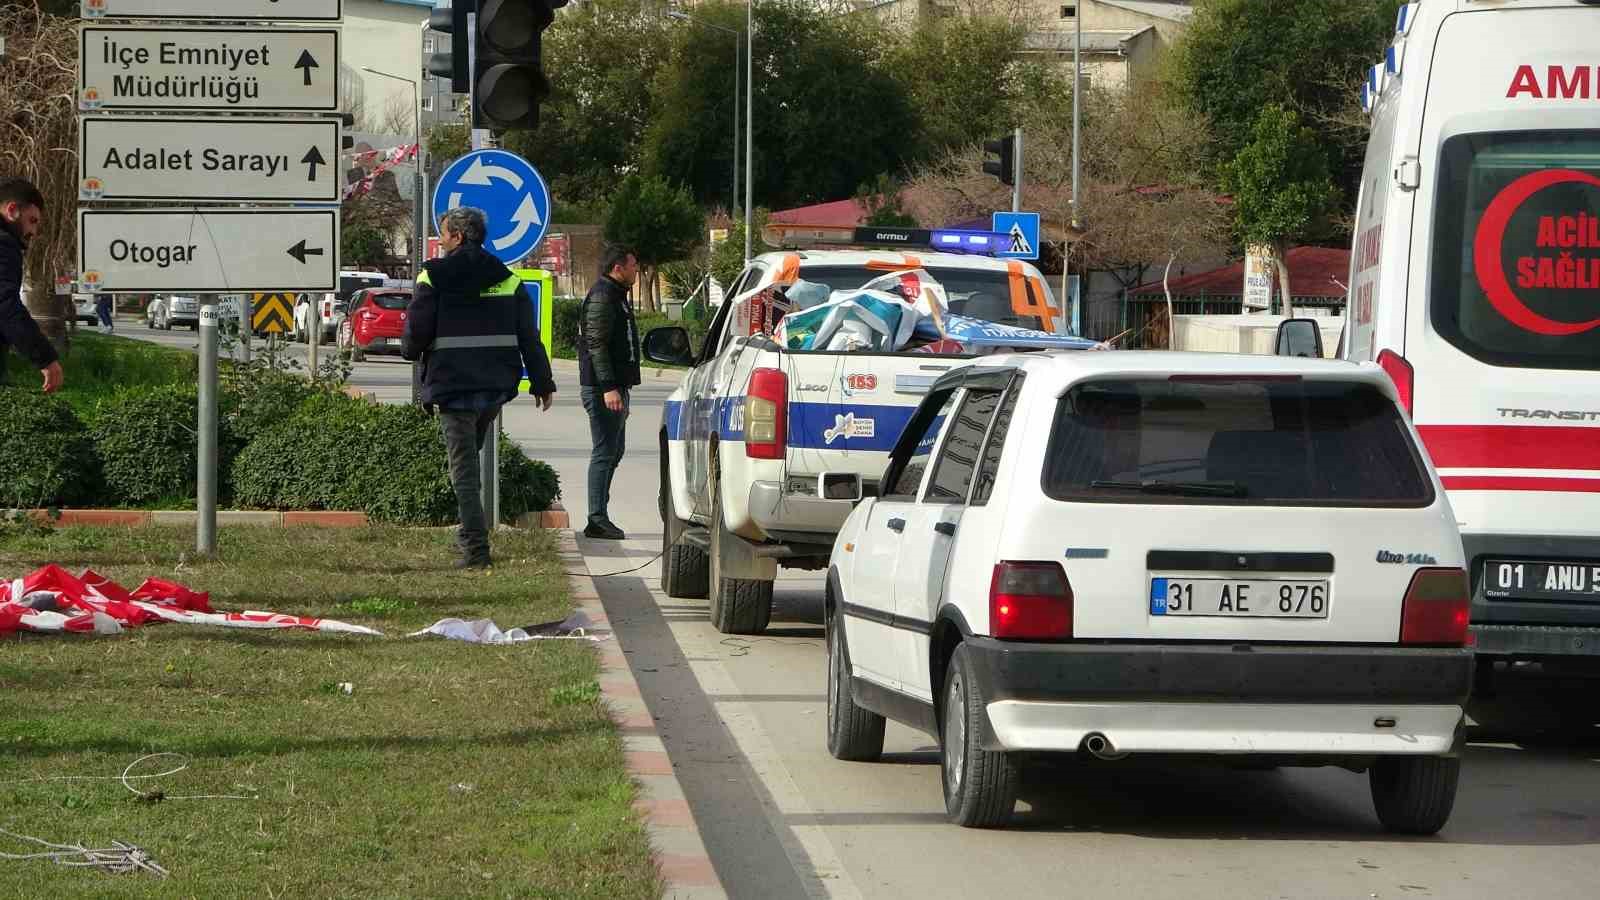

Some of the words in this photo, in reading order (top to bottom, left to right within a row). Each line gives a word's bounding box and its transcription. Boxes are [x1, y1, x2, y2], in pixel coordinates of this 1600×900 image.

[104, 37, 149, 69] İlçe
[160, 42, 269, 71] Emniyet
[113, 74, 259, 103] Müdürlüğü
[1505, 64, 1600, 98] AM
[103, 147, 193, 171] Adalet
[202, 149, 288, 177] Sarayı
[1536, 211, 1600, 247] ACİL
[109, 239, 198, 268] Otogar
[1497, 408, 1600, 420] TRANSIT
[1498, 563, 1524, 588] 01
[1545, 565, 1585, 590] ANU
[1155, 599, 1166, 608] TR
[1168, 583, 1193, 612] 31
[1219, 584, 1250, 612] AE
[1278, 586, 1324, 613] 876
